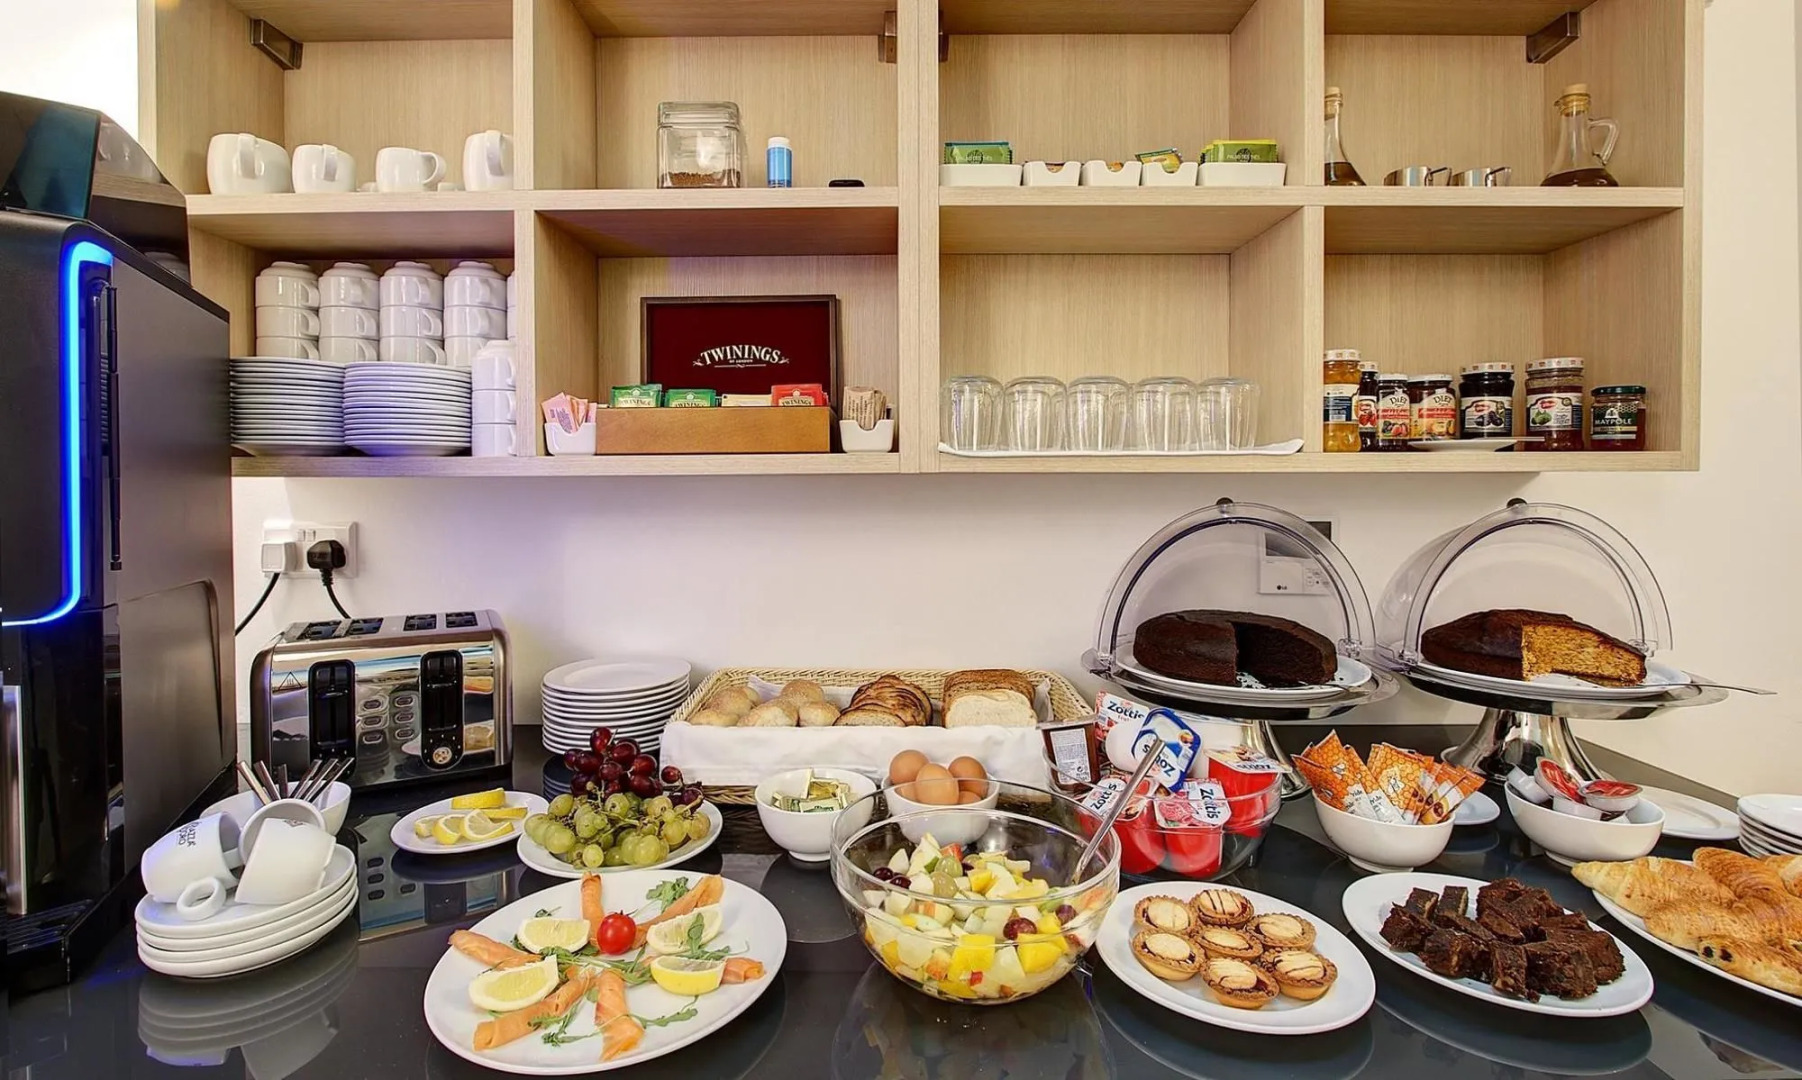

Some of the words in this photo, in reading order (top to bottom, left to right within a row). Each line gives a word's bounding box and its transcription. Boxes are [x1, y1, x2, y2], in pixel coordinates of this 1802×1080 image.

[700, 345, 781, 365] TWININGS
[1390, 395, 1408, 405] DIET
[1433, 395, 1453, 404] DIET
[1594, 417, 1633, 425] MAYPOLE
[1142, 744, 1176, 777] Zots
[1091, 783, 1117, 810] Zotts
